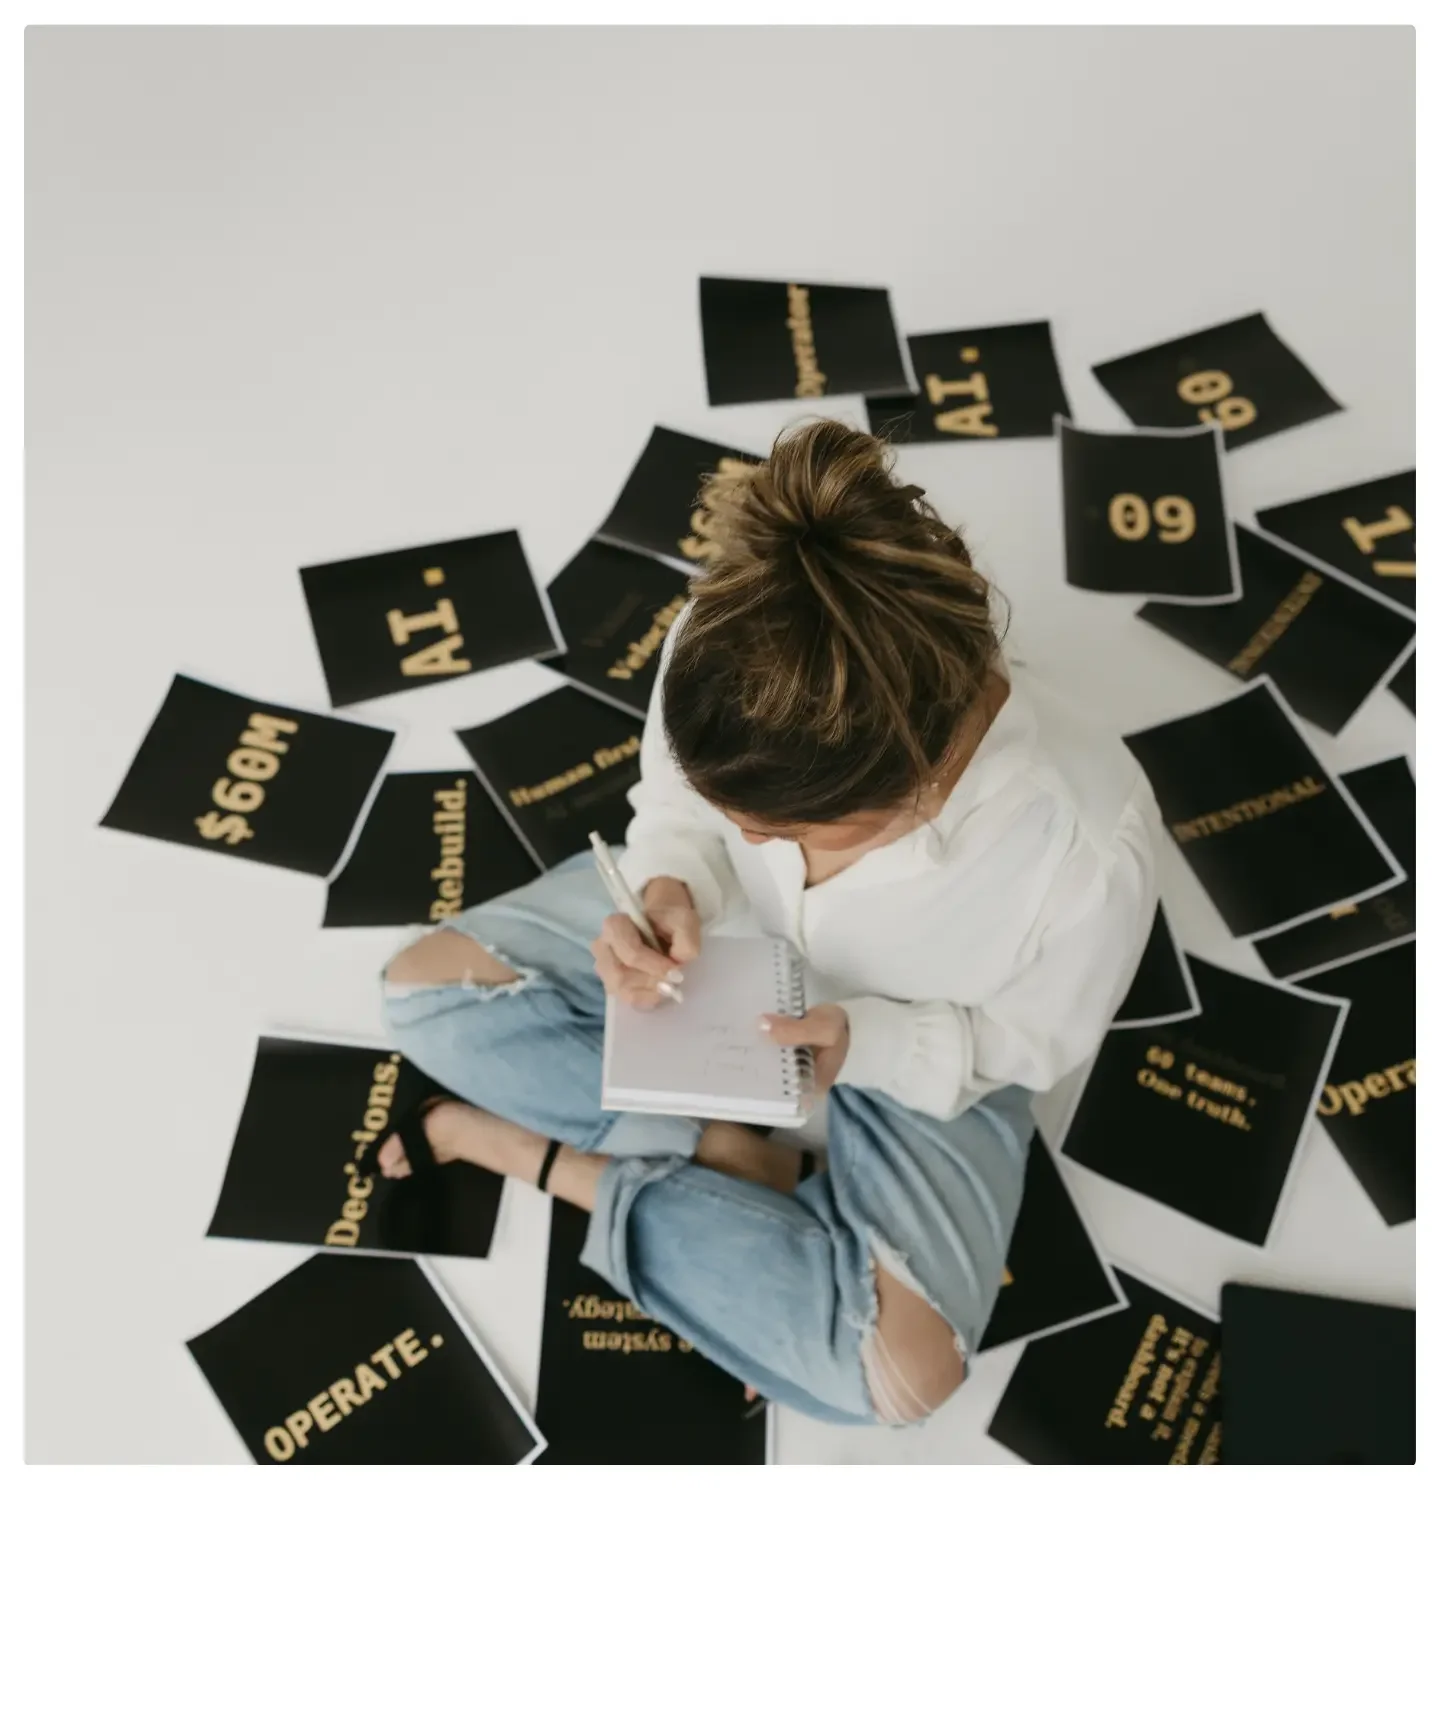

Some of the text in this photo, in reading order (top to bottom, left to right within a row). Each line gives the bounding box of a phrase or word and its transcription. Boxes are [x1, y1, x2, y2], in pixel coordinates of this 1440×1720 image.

[927, 346, 999, 437] AI.
[387, 567, 472, 677] AI.
[195, 712, 299, 845] $60M
[430, 778, 467, 921] Rebuild.
[1137, 1068, 1183, 1100] One
[324, 1052, 402, 1246] Decions.
[264, 1327, 444, 1461] OPERATE.
[583, 1329, 672, 1354] system
